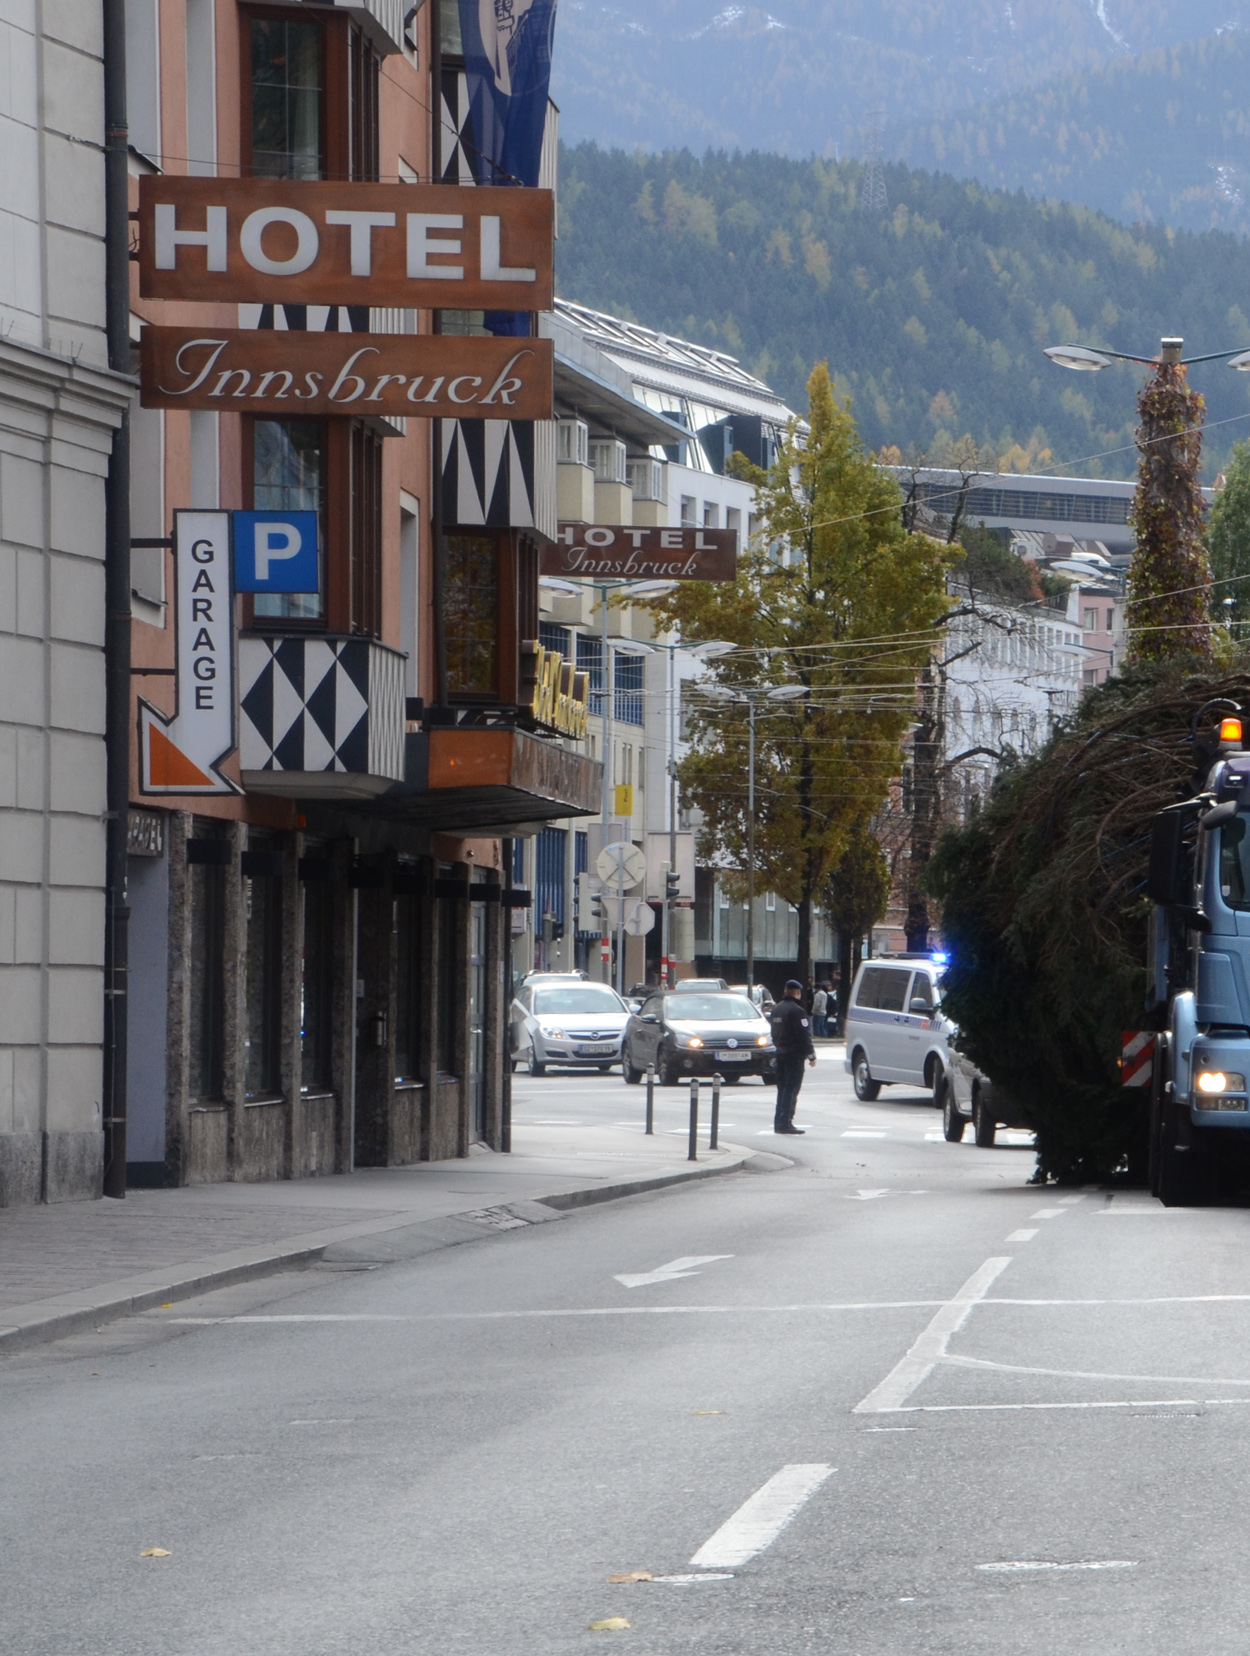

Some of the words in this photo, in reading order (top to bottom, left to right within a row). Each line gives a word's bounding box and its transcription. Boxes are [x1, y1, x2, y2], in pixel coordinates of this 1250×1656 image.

[153, 203, 538, 283] HOTEL
[158, 337, 536, 407] Innsbruck
[254, 522, 302, 581] P
[557, 526, 718, 550] HOTEL
[561, 546, 701, 576] Innsbruck
[191, 539, 216, 710] GARAGE
